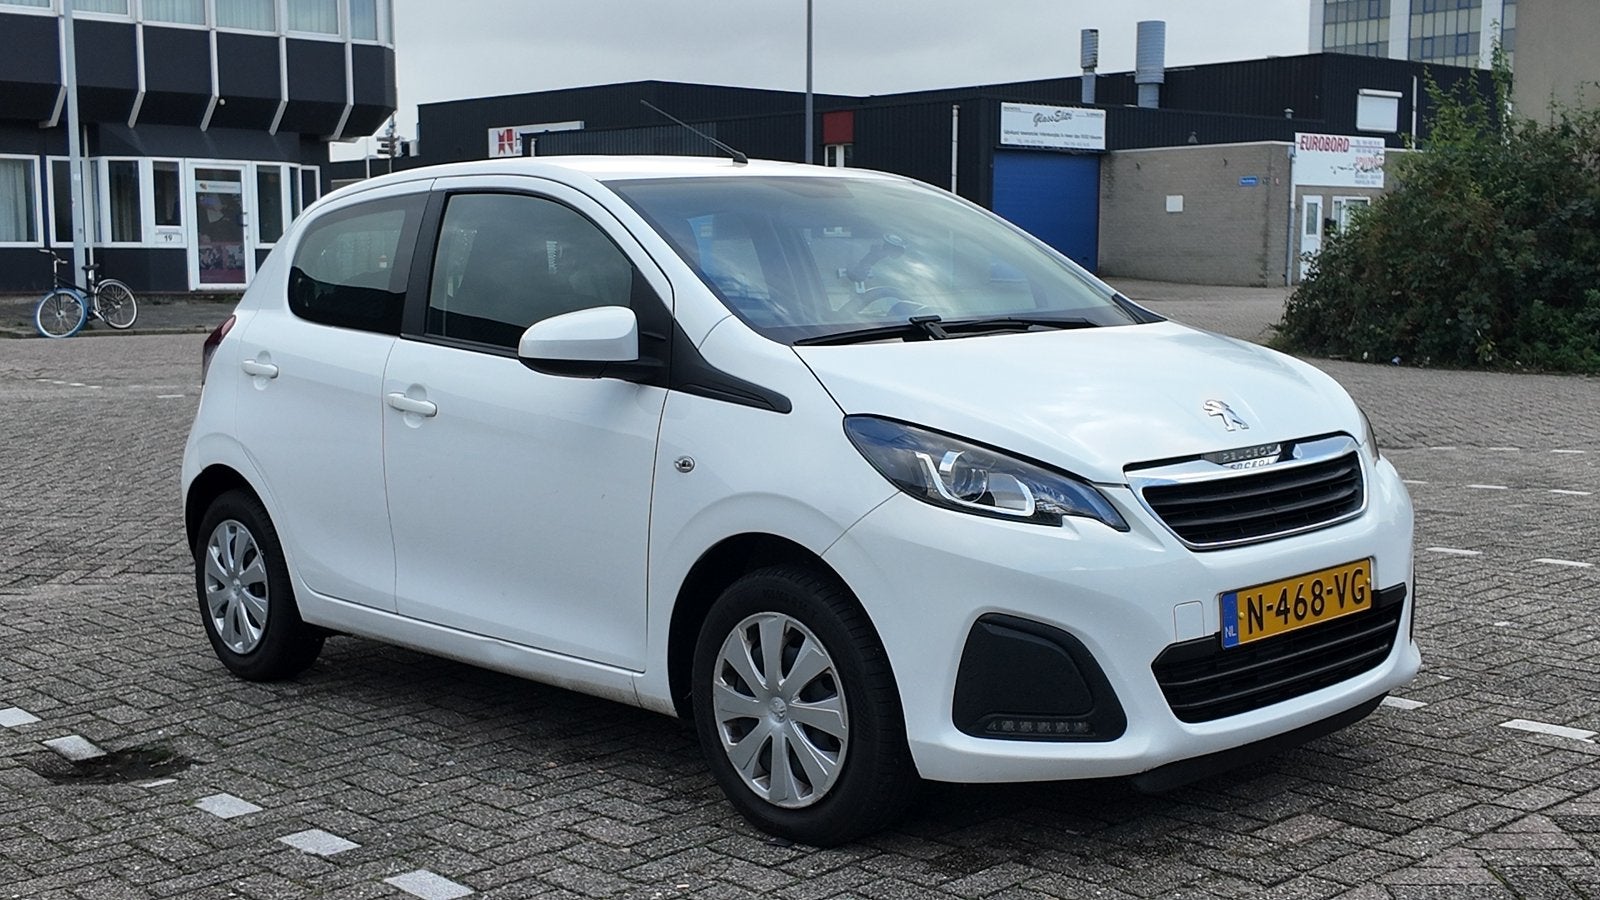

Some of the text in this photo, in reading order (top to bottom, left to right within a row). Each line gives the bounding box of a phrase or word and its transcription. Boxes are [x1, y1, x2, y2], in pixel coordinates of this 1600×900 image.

[1299, 135, 1350, 153] EUROBORD
[164, 234, 173, 242] 19
[1247, 567, 1366, 635] N-468-VG
[1224, 625, 1237, 639] NL
